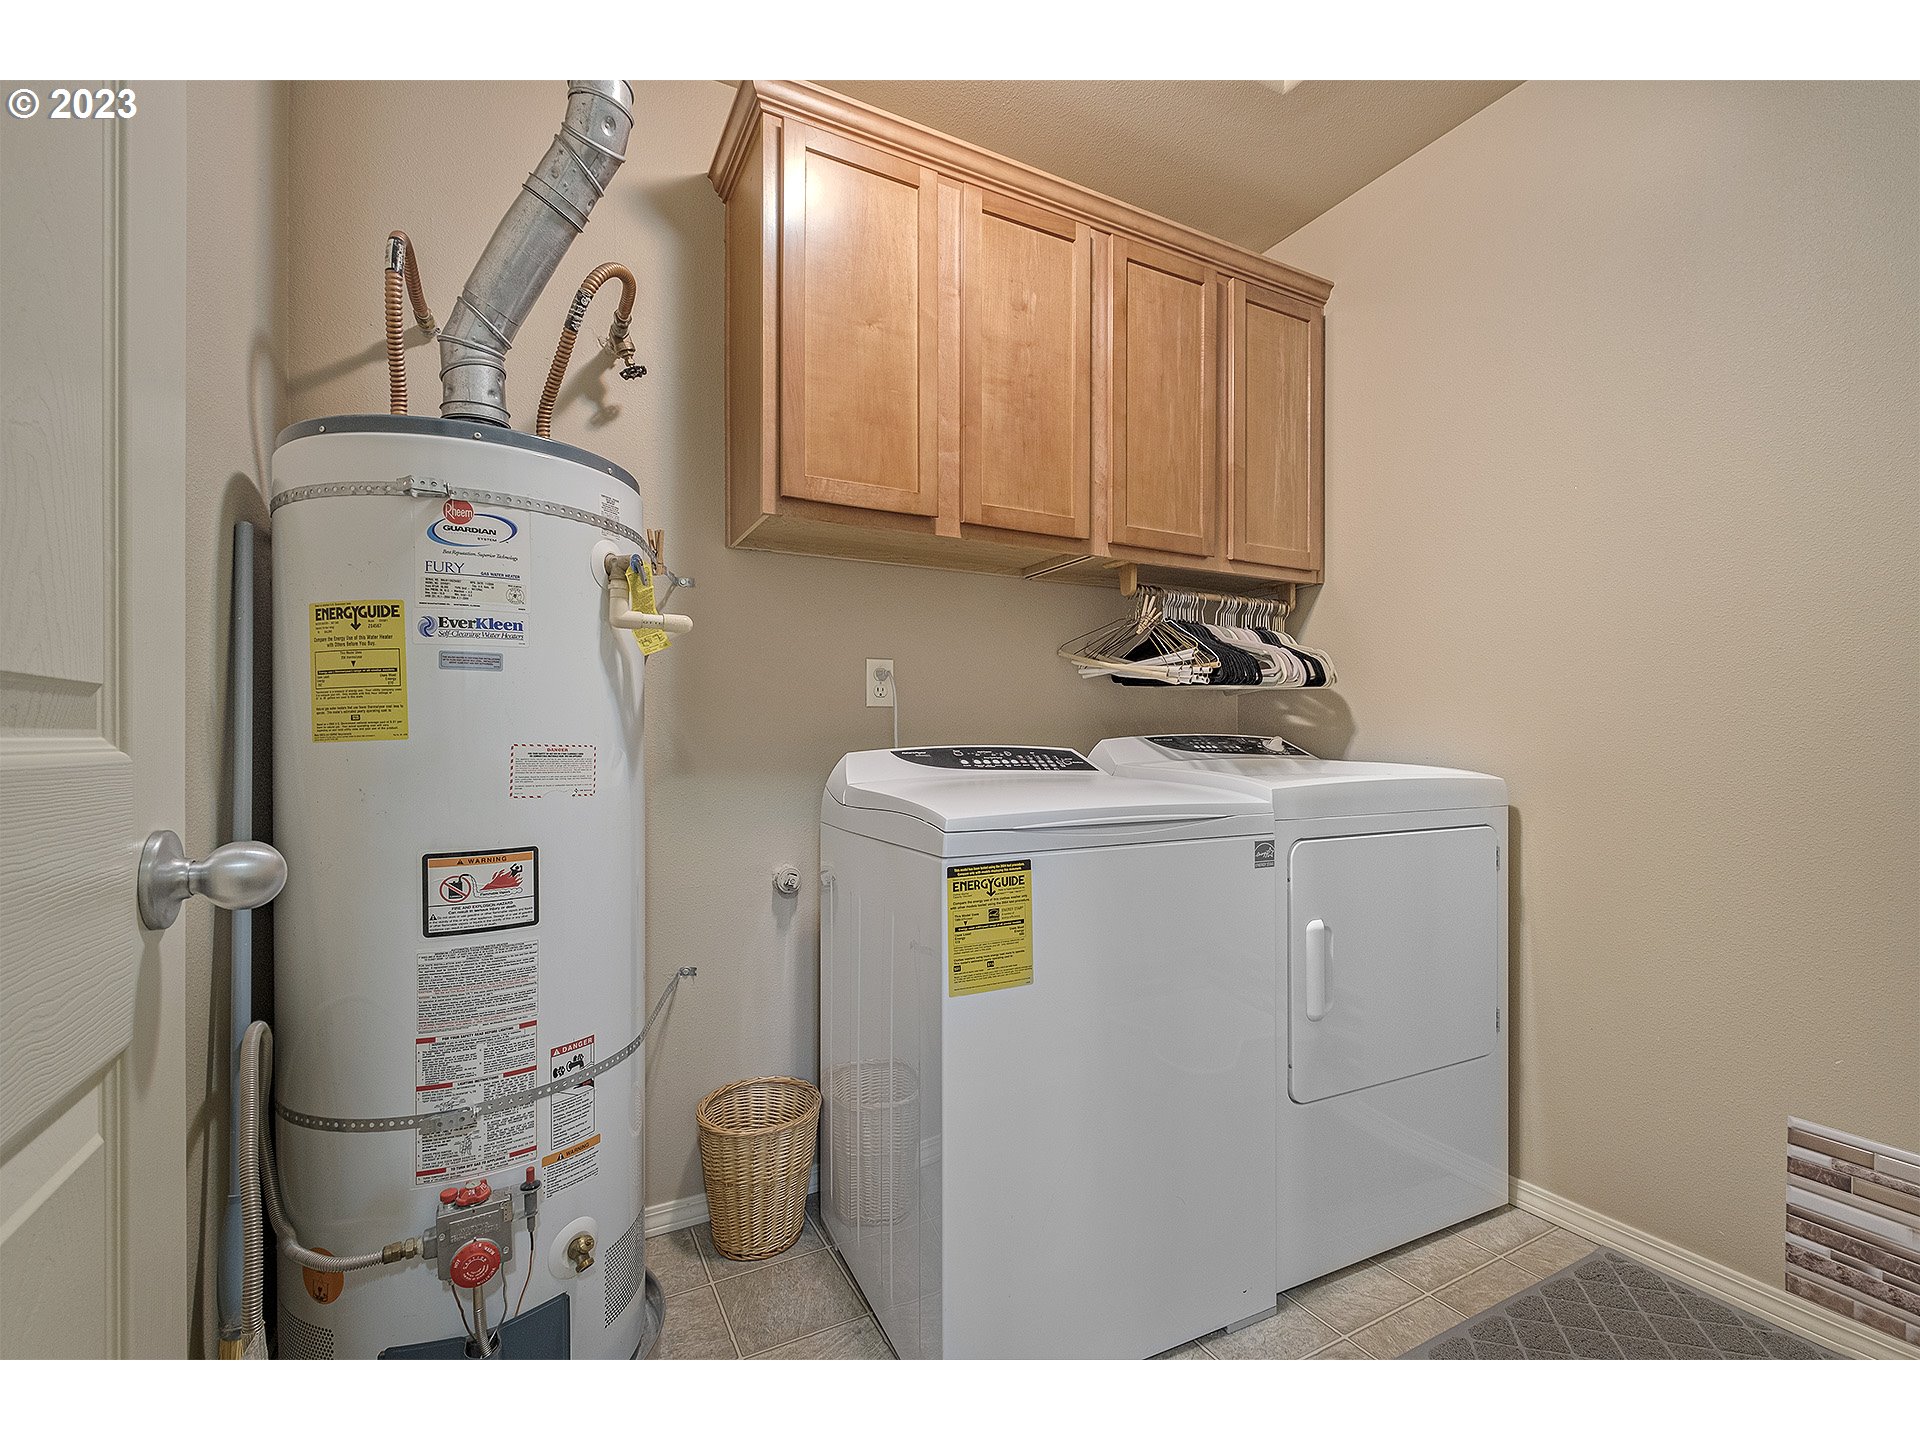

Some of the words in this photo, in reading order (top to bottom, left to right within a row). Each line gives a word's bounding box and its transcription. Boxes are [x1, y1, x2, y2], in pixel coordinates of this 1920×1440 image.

[446, 500, 472, 520] Rheem
[443, 525, 497, 535] GUARDIAN
[425, 560, 464, 573] FURY
[315, 605, 400, 621] ENERGYGUIDE
[438, 617, 523, 631] EverKleen
[438, 631, 481, 639] Self-Cleaning
[481, 631, 500, 639] Water
[467, 856, 507, 864] WARNING
[953, 875, 1025, 892] ENERGYGUIDE
[561, 1037, 593, 1053] DANGER
[565, 1142, 590, 1156] WARNING
